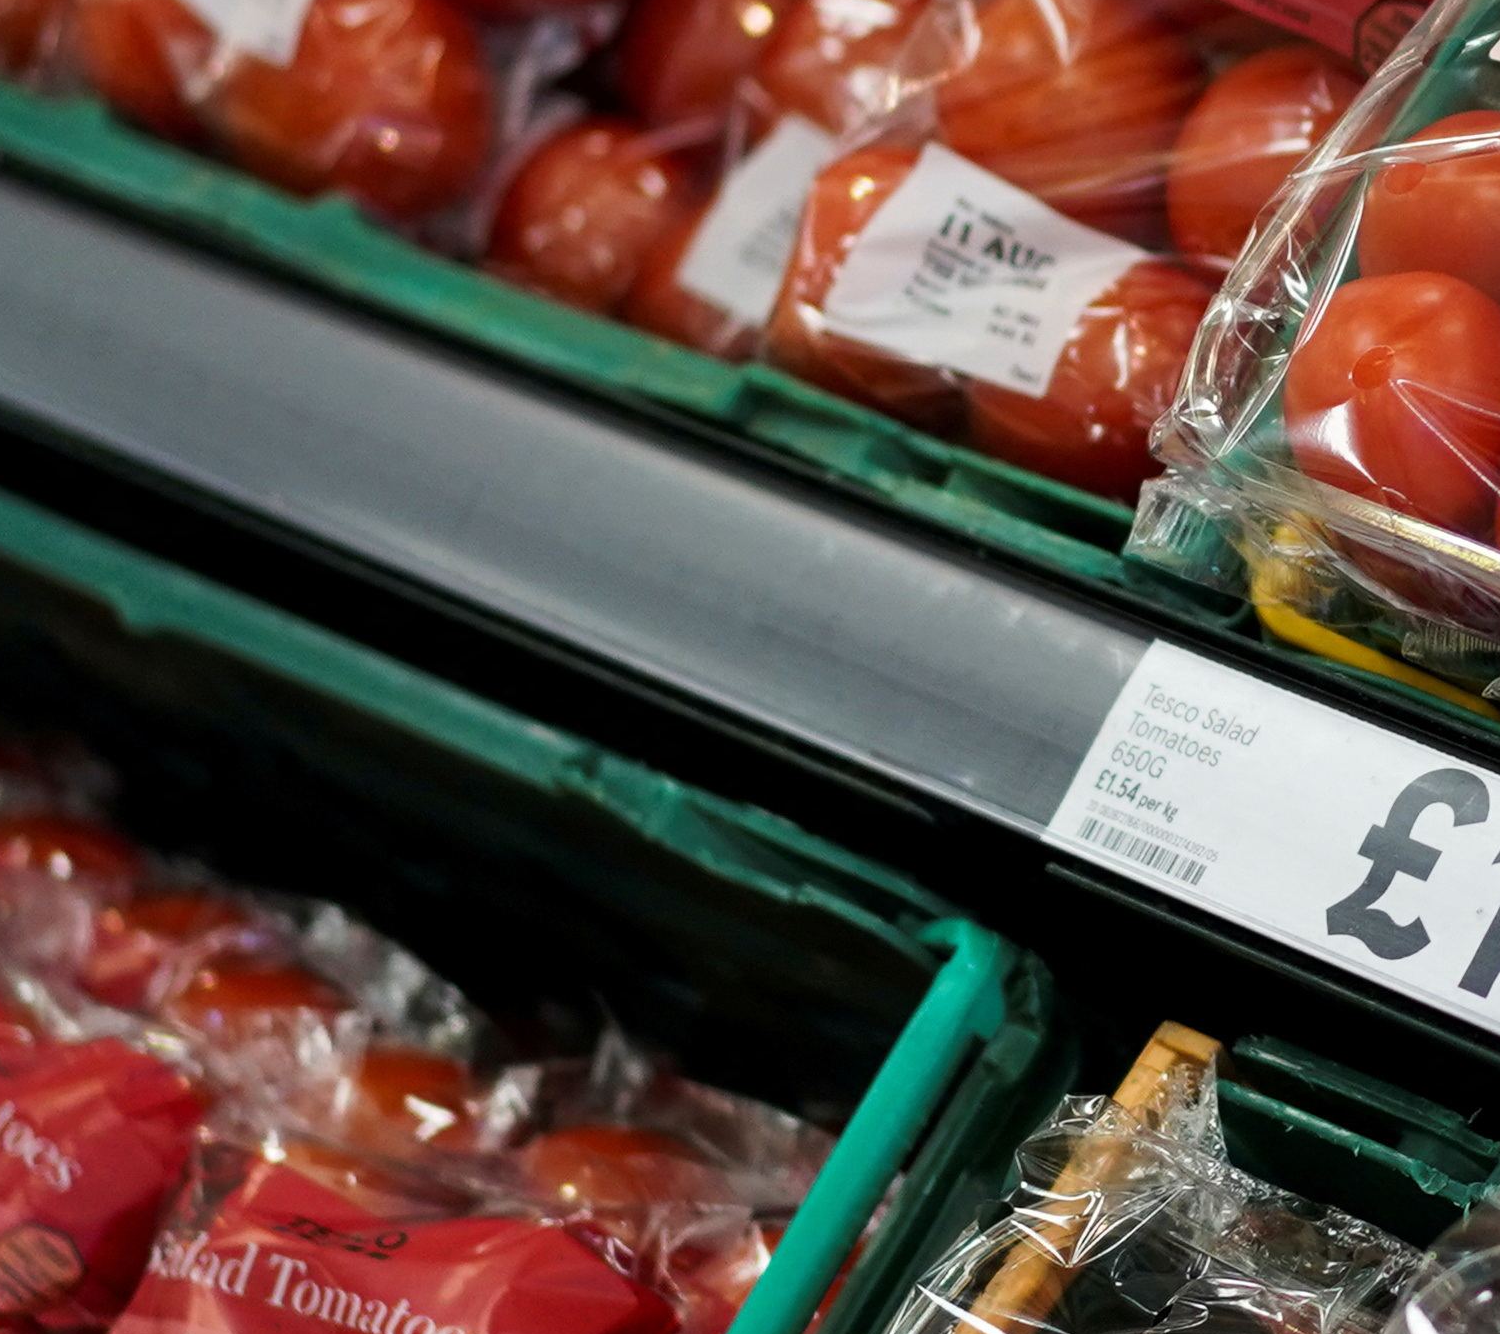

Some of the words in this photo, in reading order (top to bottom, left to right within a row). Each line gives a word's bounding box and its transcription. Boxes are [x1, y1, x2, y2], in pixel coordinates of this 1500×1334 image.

[1127, 710, 1222, 768] Tomatoes
[1144, 683, 1199, 723] Tesco
[1202, 708, 1261, 747] Salad
[1111, 740, 1167, 780] 650G
[1094, 769, 1142, 803] £1.54
[1136, 792, 1162, 812] per
[1163, 801, 1179, 823] kg
